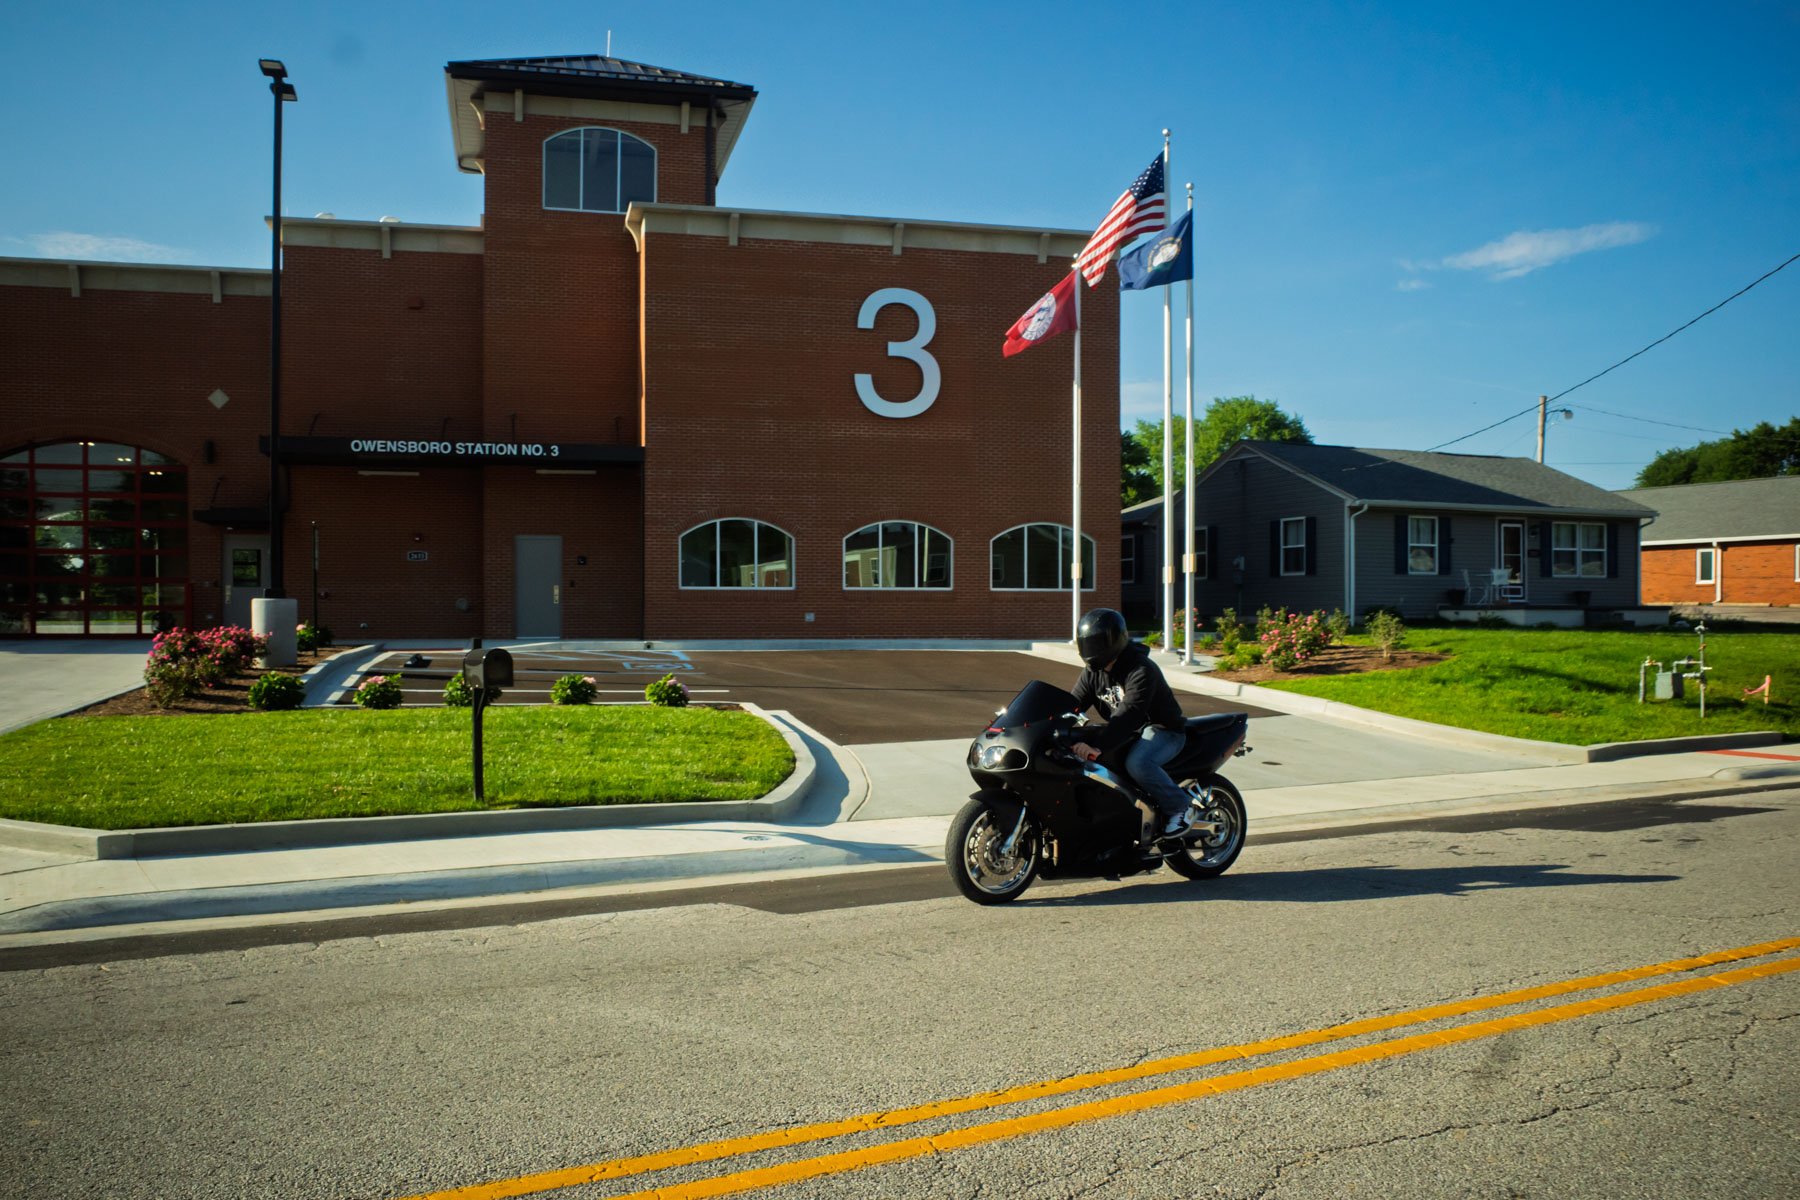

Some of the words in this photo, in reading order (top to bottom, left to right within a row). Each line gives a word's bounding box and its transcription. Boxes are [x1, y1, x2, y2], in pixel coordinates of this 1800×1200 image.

[854, 287, 941, 418] 3
[351, 440, 451, 454] OWENSBORO
[455, 442, 517, 455] STATION
[521, 444, 547, 456] NO.
[550, 445, 559, 457] 3
